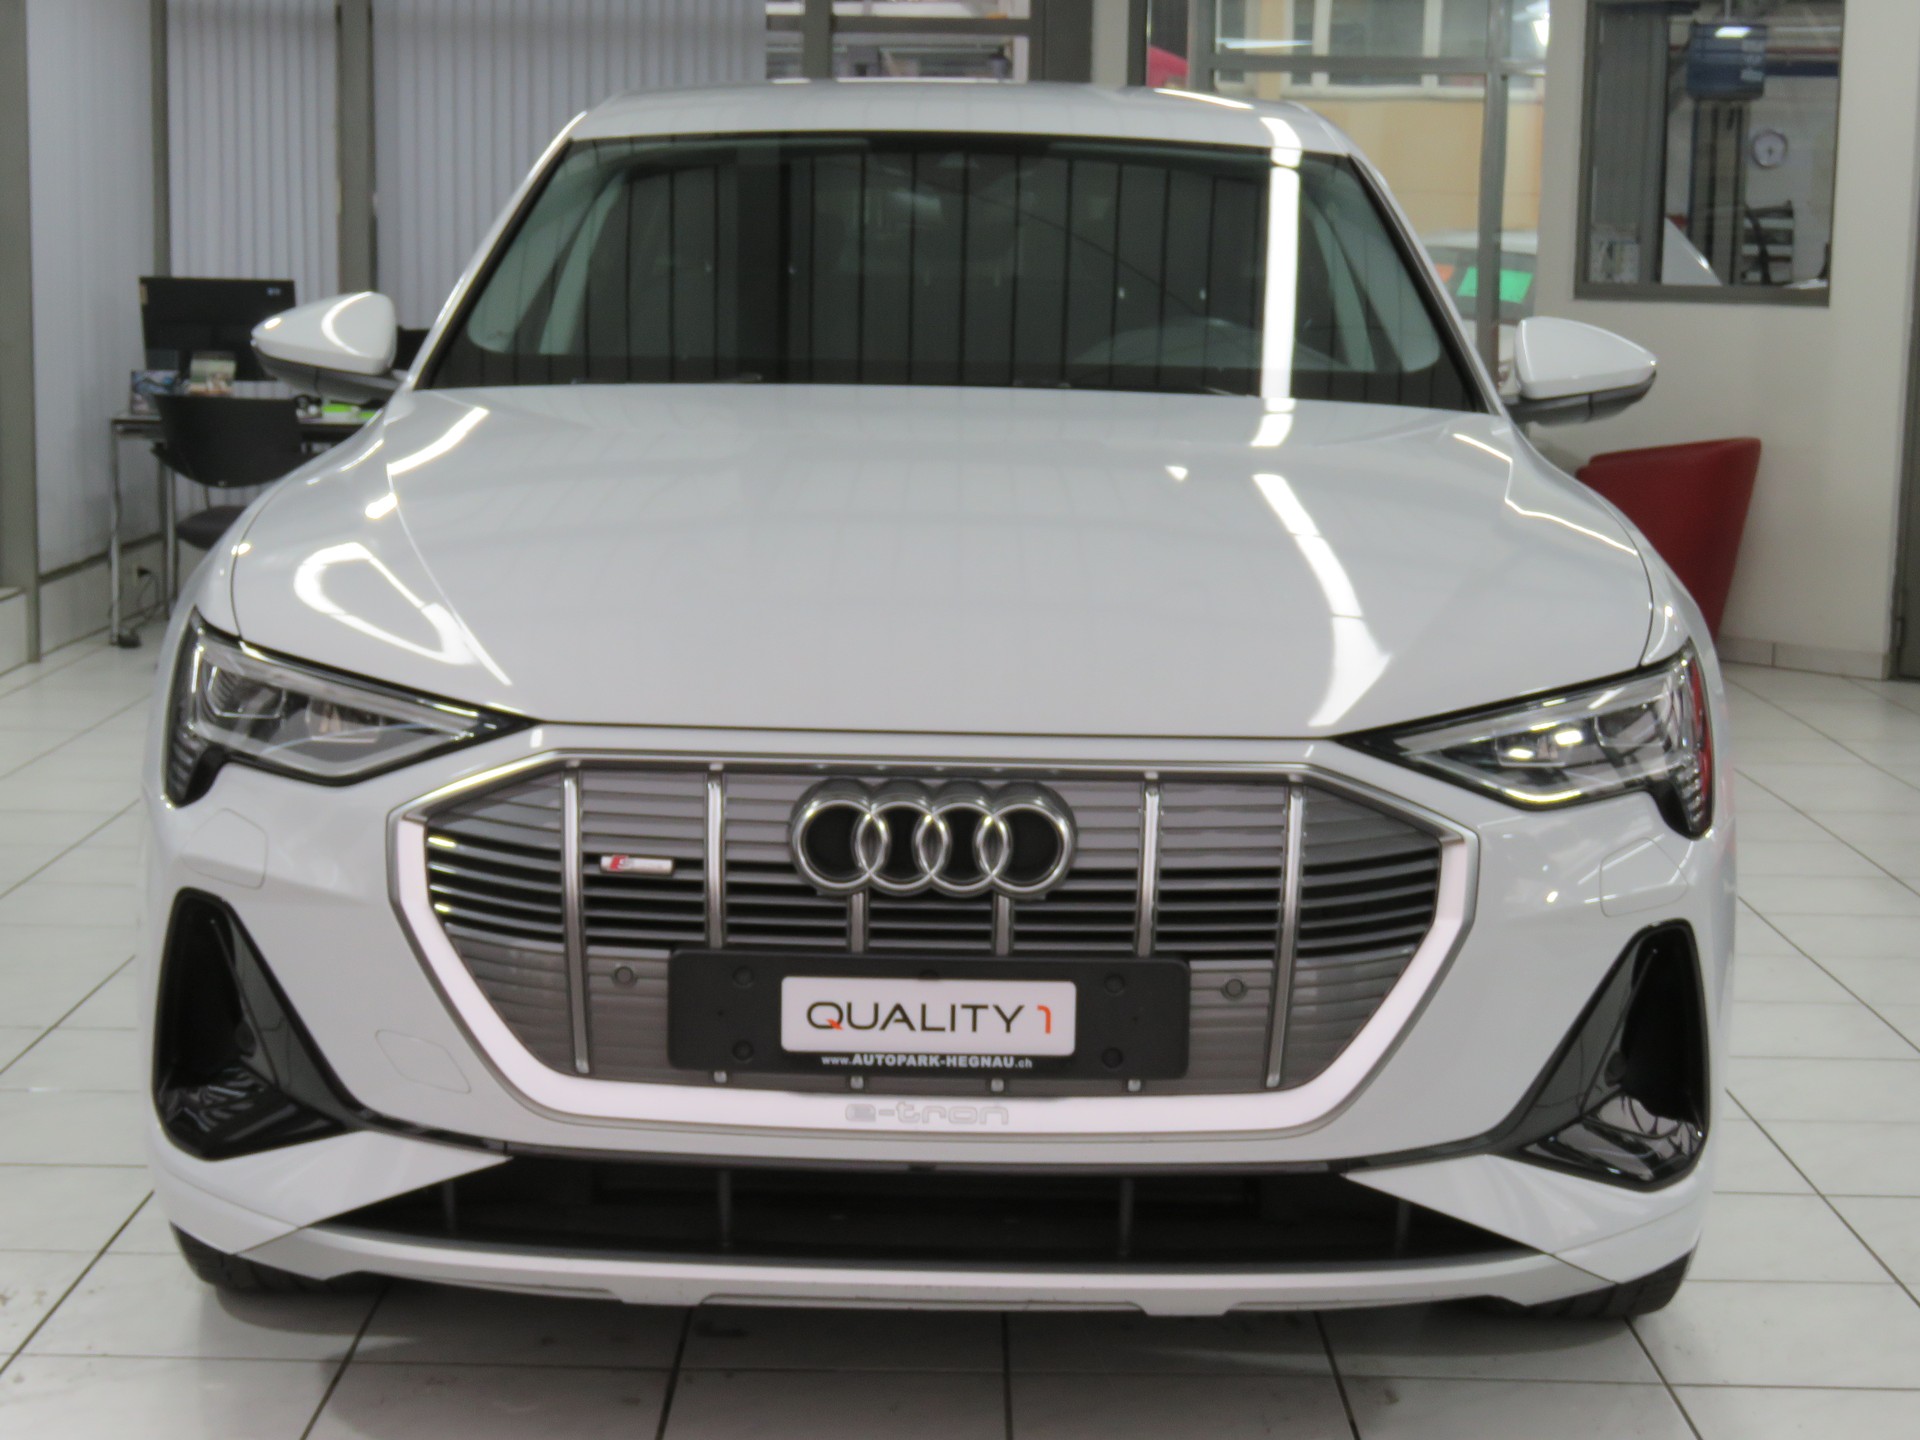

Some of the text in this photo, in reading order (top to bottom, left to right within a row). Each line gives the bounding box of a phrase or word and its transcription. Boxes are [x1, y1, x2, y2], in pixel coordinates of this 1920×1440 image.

[806, 1001, 1052, 1035] QUALITY 1
[821, 1053, 1033, 1069] www.AUTOPARK-HEGNAU.ch
[844, 1101, 1010, 1126] e-tron
